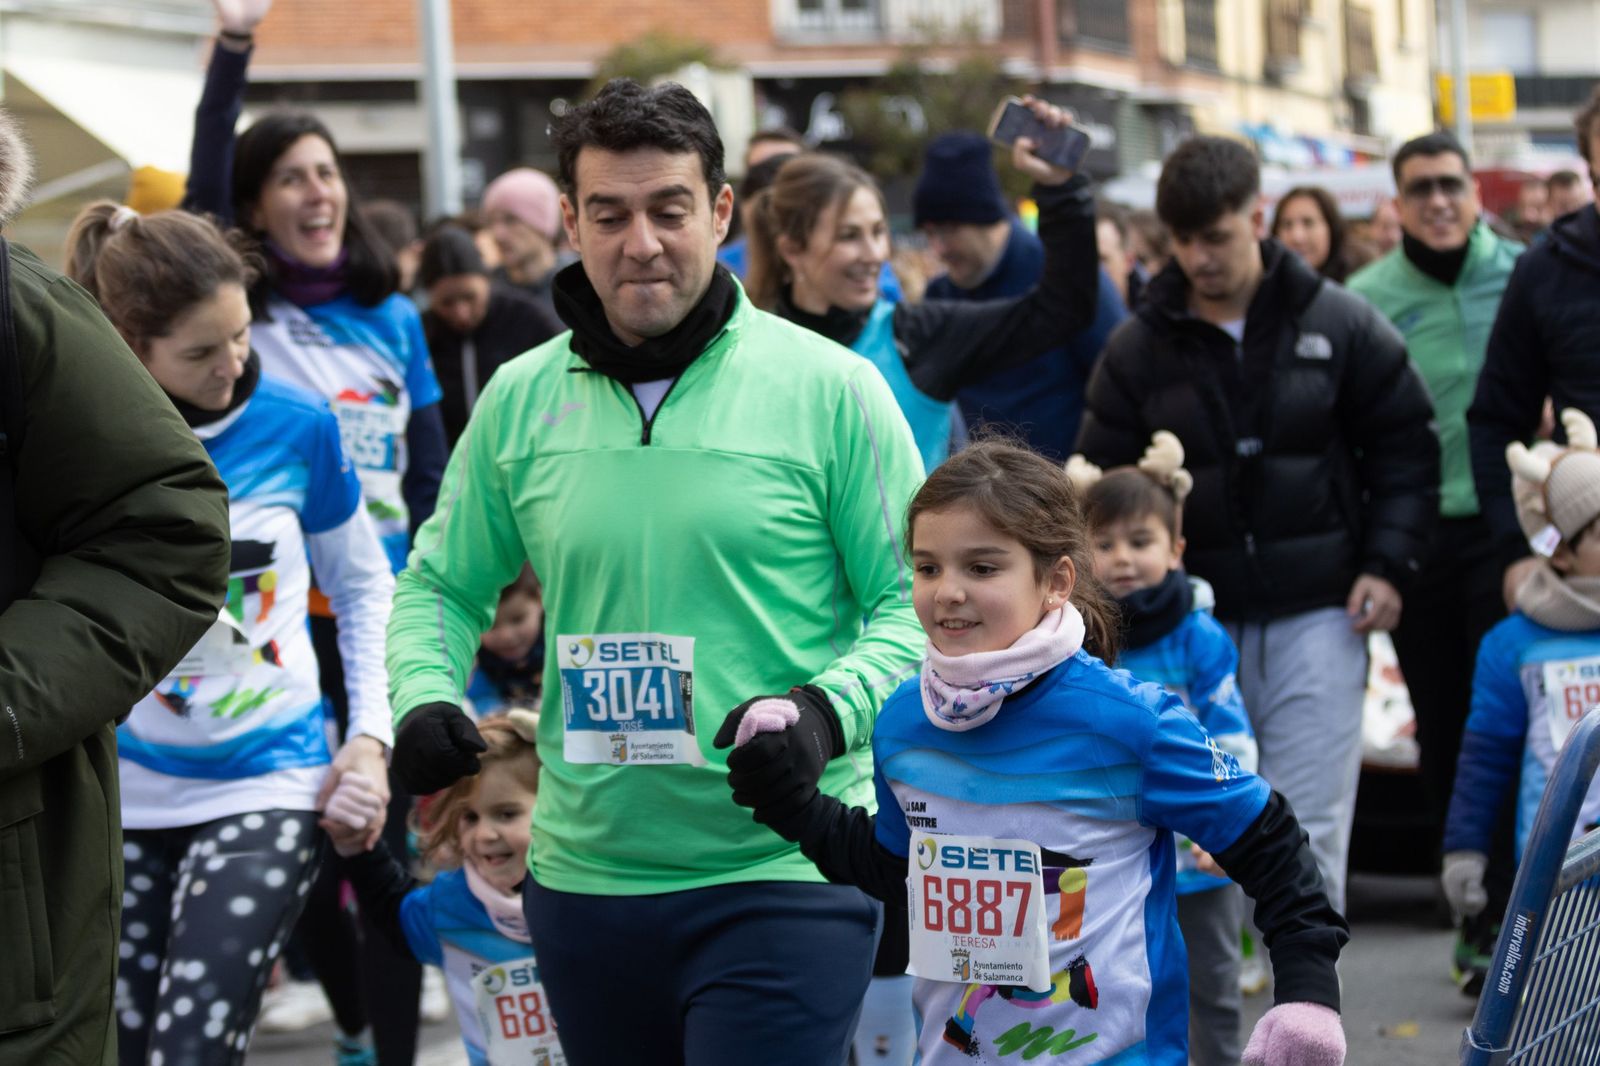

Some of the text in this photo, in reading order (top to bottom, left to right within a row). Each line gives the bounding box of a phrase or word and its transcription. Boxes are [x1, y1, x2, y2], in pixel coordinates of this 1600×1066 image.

[600, 641, 680, 664] SETEL
[583, 669, 674, 721] 3041
[640, 752, 674, 761] Salamanca
[911, 801, 926, 813] SAN
[906, 815, 937, 828] VESTRE
[941, 846, 1040, 876] SETEL
[923, 875, 1032, 938] 6887
[953, 935, 997, 949] TERESA
[1498, 914, 1532, 994] intervallas.com
[974, 960, 1023, 972] Ayuntamiento
[974, 972, 1023, 982] de Salamanca
[495, 992, 558, 1039] 68
